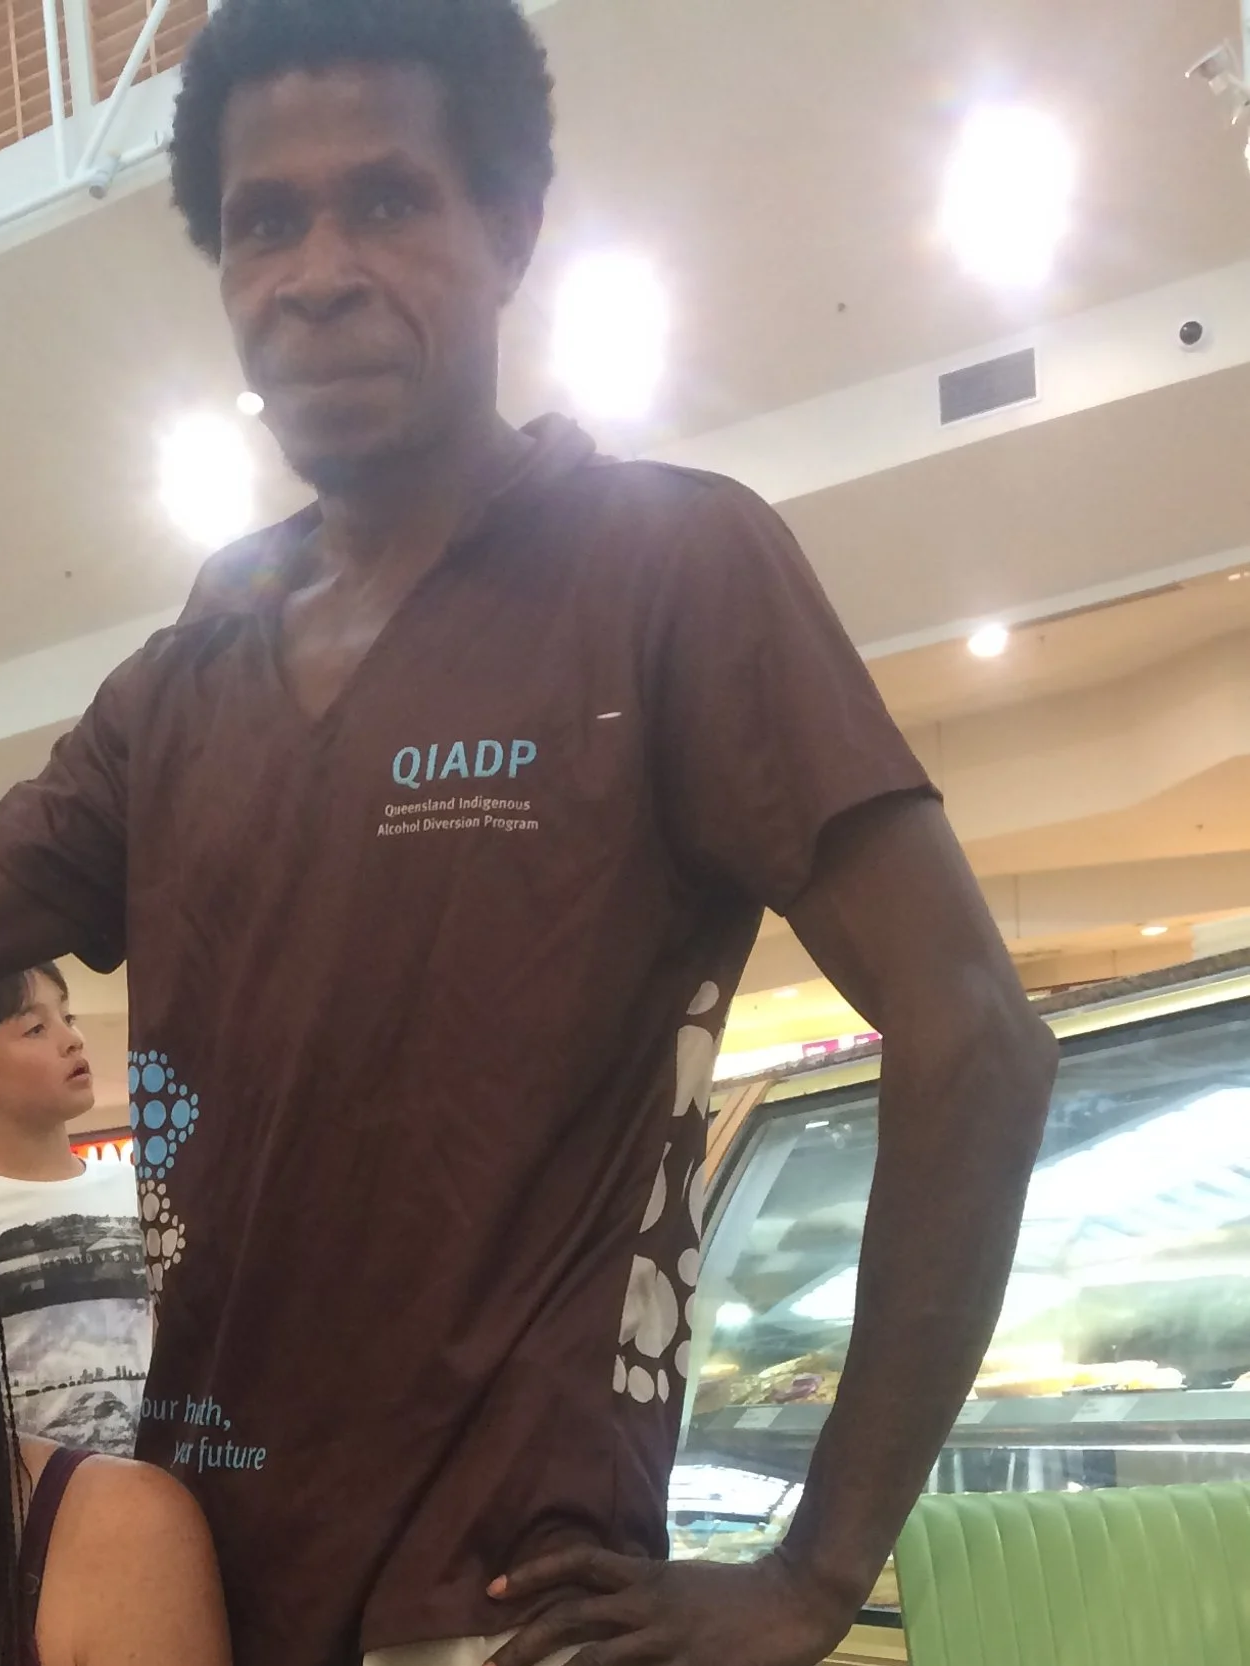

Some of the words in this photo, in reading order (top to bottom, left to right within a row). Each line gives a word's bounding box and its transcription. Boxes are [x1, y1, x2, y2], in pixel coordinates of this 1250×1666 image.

[392, 739, 538, 789] QIADP
[384, 796, 456, 818] Queensland
[459, 795, 531, 811] Indigenous
[376, 819, 420, 837] Alcohol
[423, 815, 480, 832] Diversion
[483, 814, 539, 832] Program
[197, 1436, 267, 1474] future
